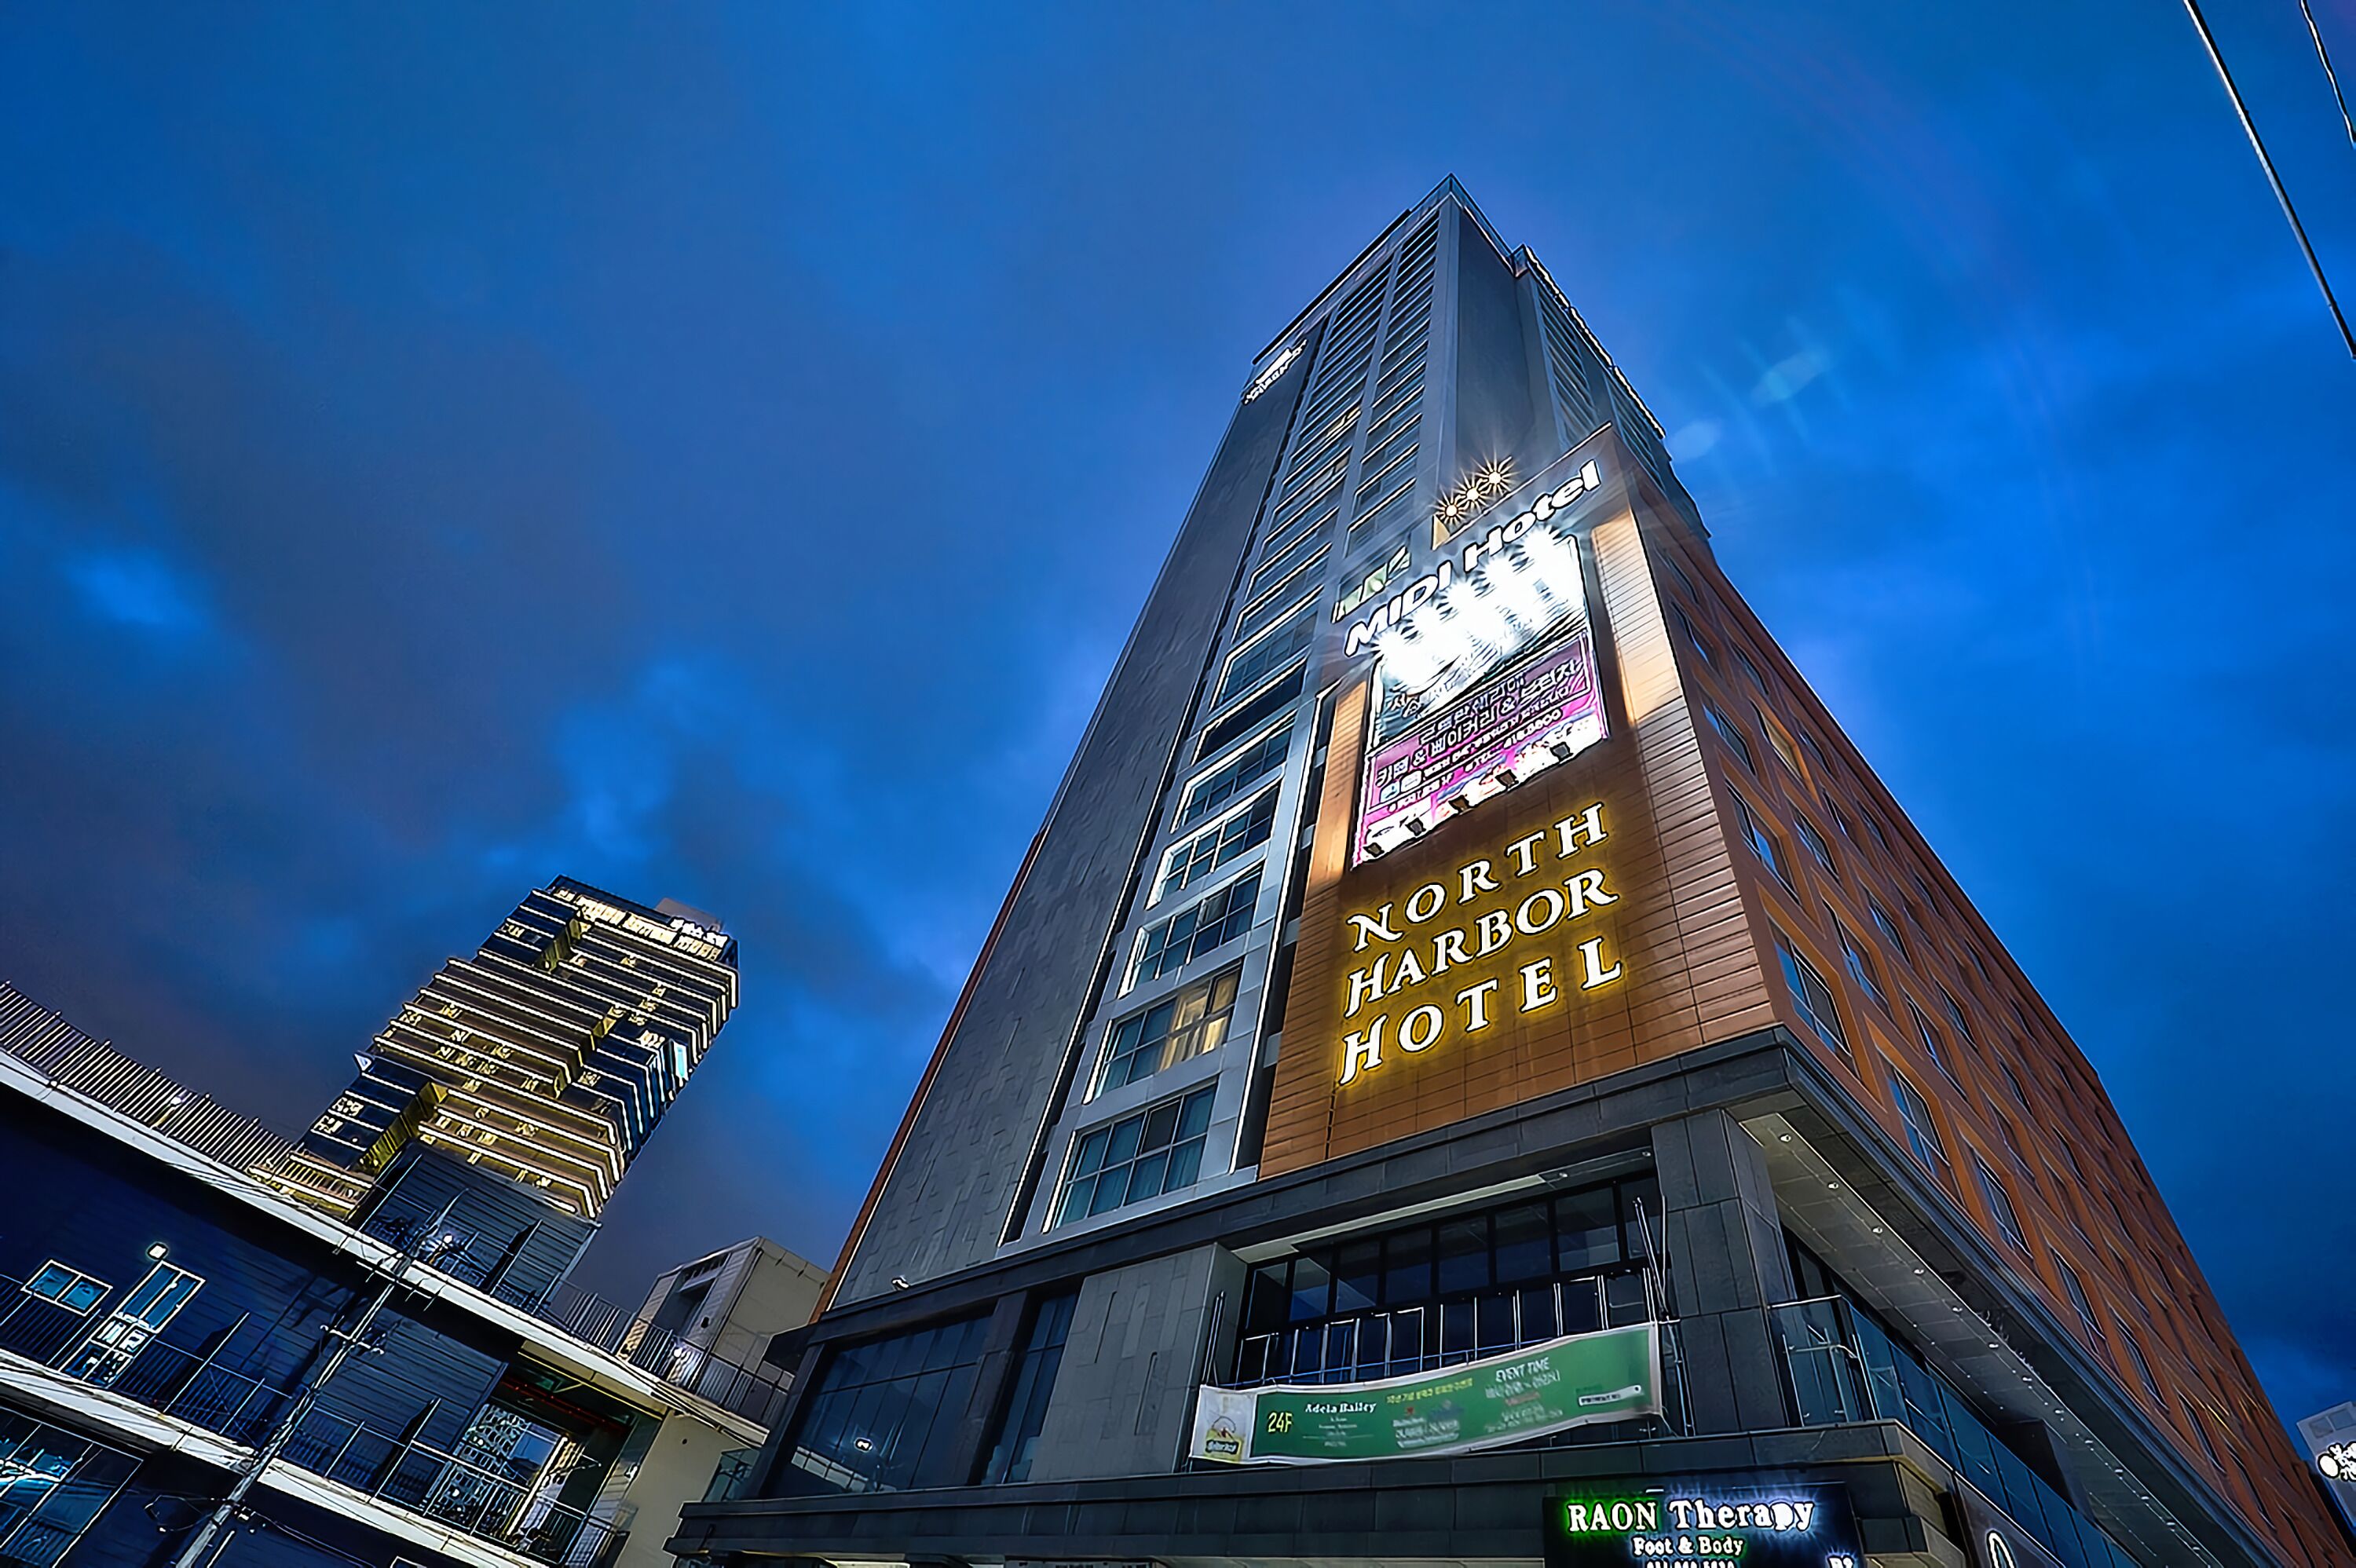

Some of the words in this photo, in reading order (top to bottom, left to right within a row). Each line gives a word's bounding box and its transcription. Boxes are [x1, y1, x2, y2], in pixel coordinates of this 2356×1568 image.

[1344, 561, 1451, 656] MIDI
[1464, 459, 1601, 572] Hotel
[1347, 802, 1608, 952] NORTH
[1344, 868, 1619, 1019] HARBOR
[1340, 938, 1622, 1085] HOTEL
[1268, 1412, 1293, 1433] 24F
[1305, 1403, 1337, 1413] Adela
[1339, 1402, 1377, 1413] Bailey
[1568, 1501, 1657, 1532] RAON
[1669, 1499, 1814, 1531] Therapy
[1632, 1537, 1674, 1555] Foot
[1677, 1537, 1694, 1553] &
[1699, 1536, 1744, 1556] Body
